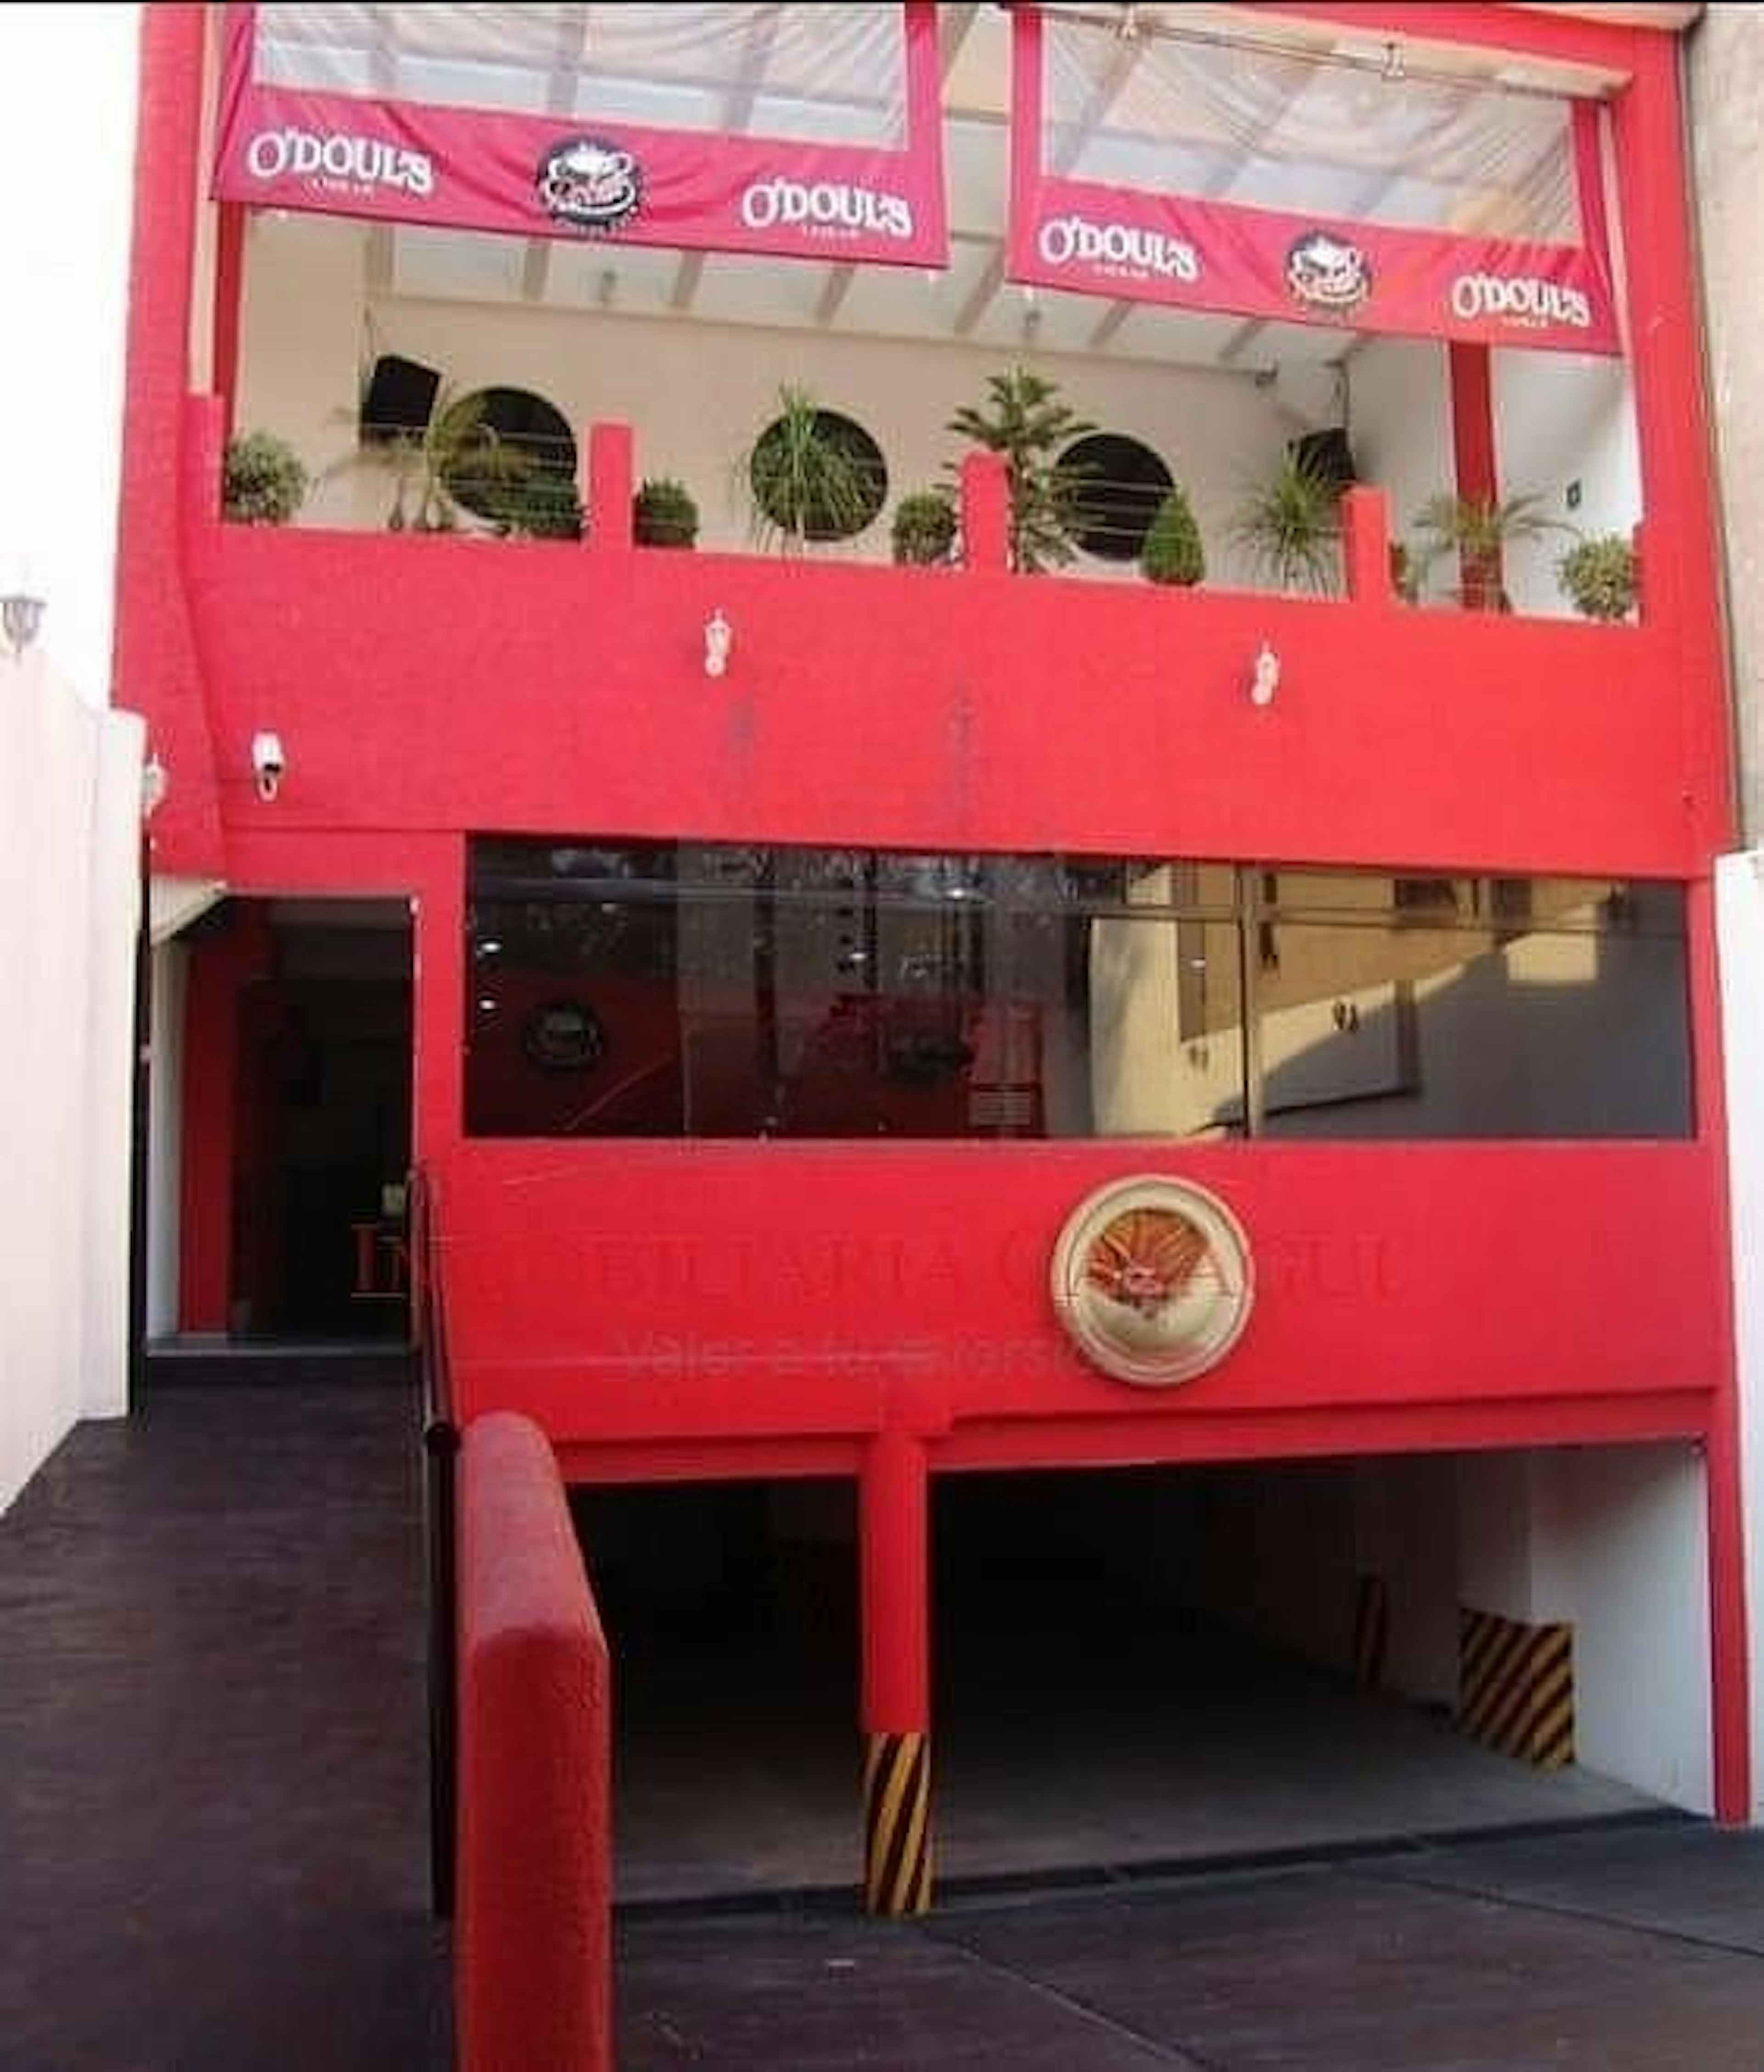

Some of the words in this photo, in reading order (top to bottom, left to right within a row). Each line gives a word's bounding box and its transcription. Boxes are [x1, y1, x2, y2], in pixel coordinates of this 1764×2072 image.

[249, 126, 434, 195] O'DOUL'S
[742, 176, 912, 239] O'DOUL'S
[1039, 215, 1199, 283] O'DOUL'S
[1452, 272, 1590, 328] O'DOUL'S
